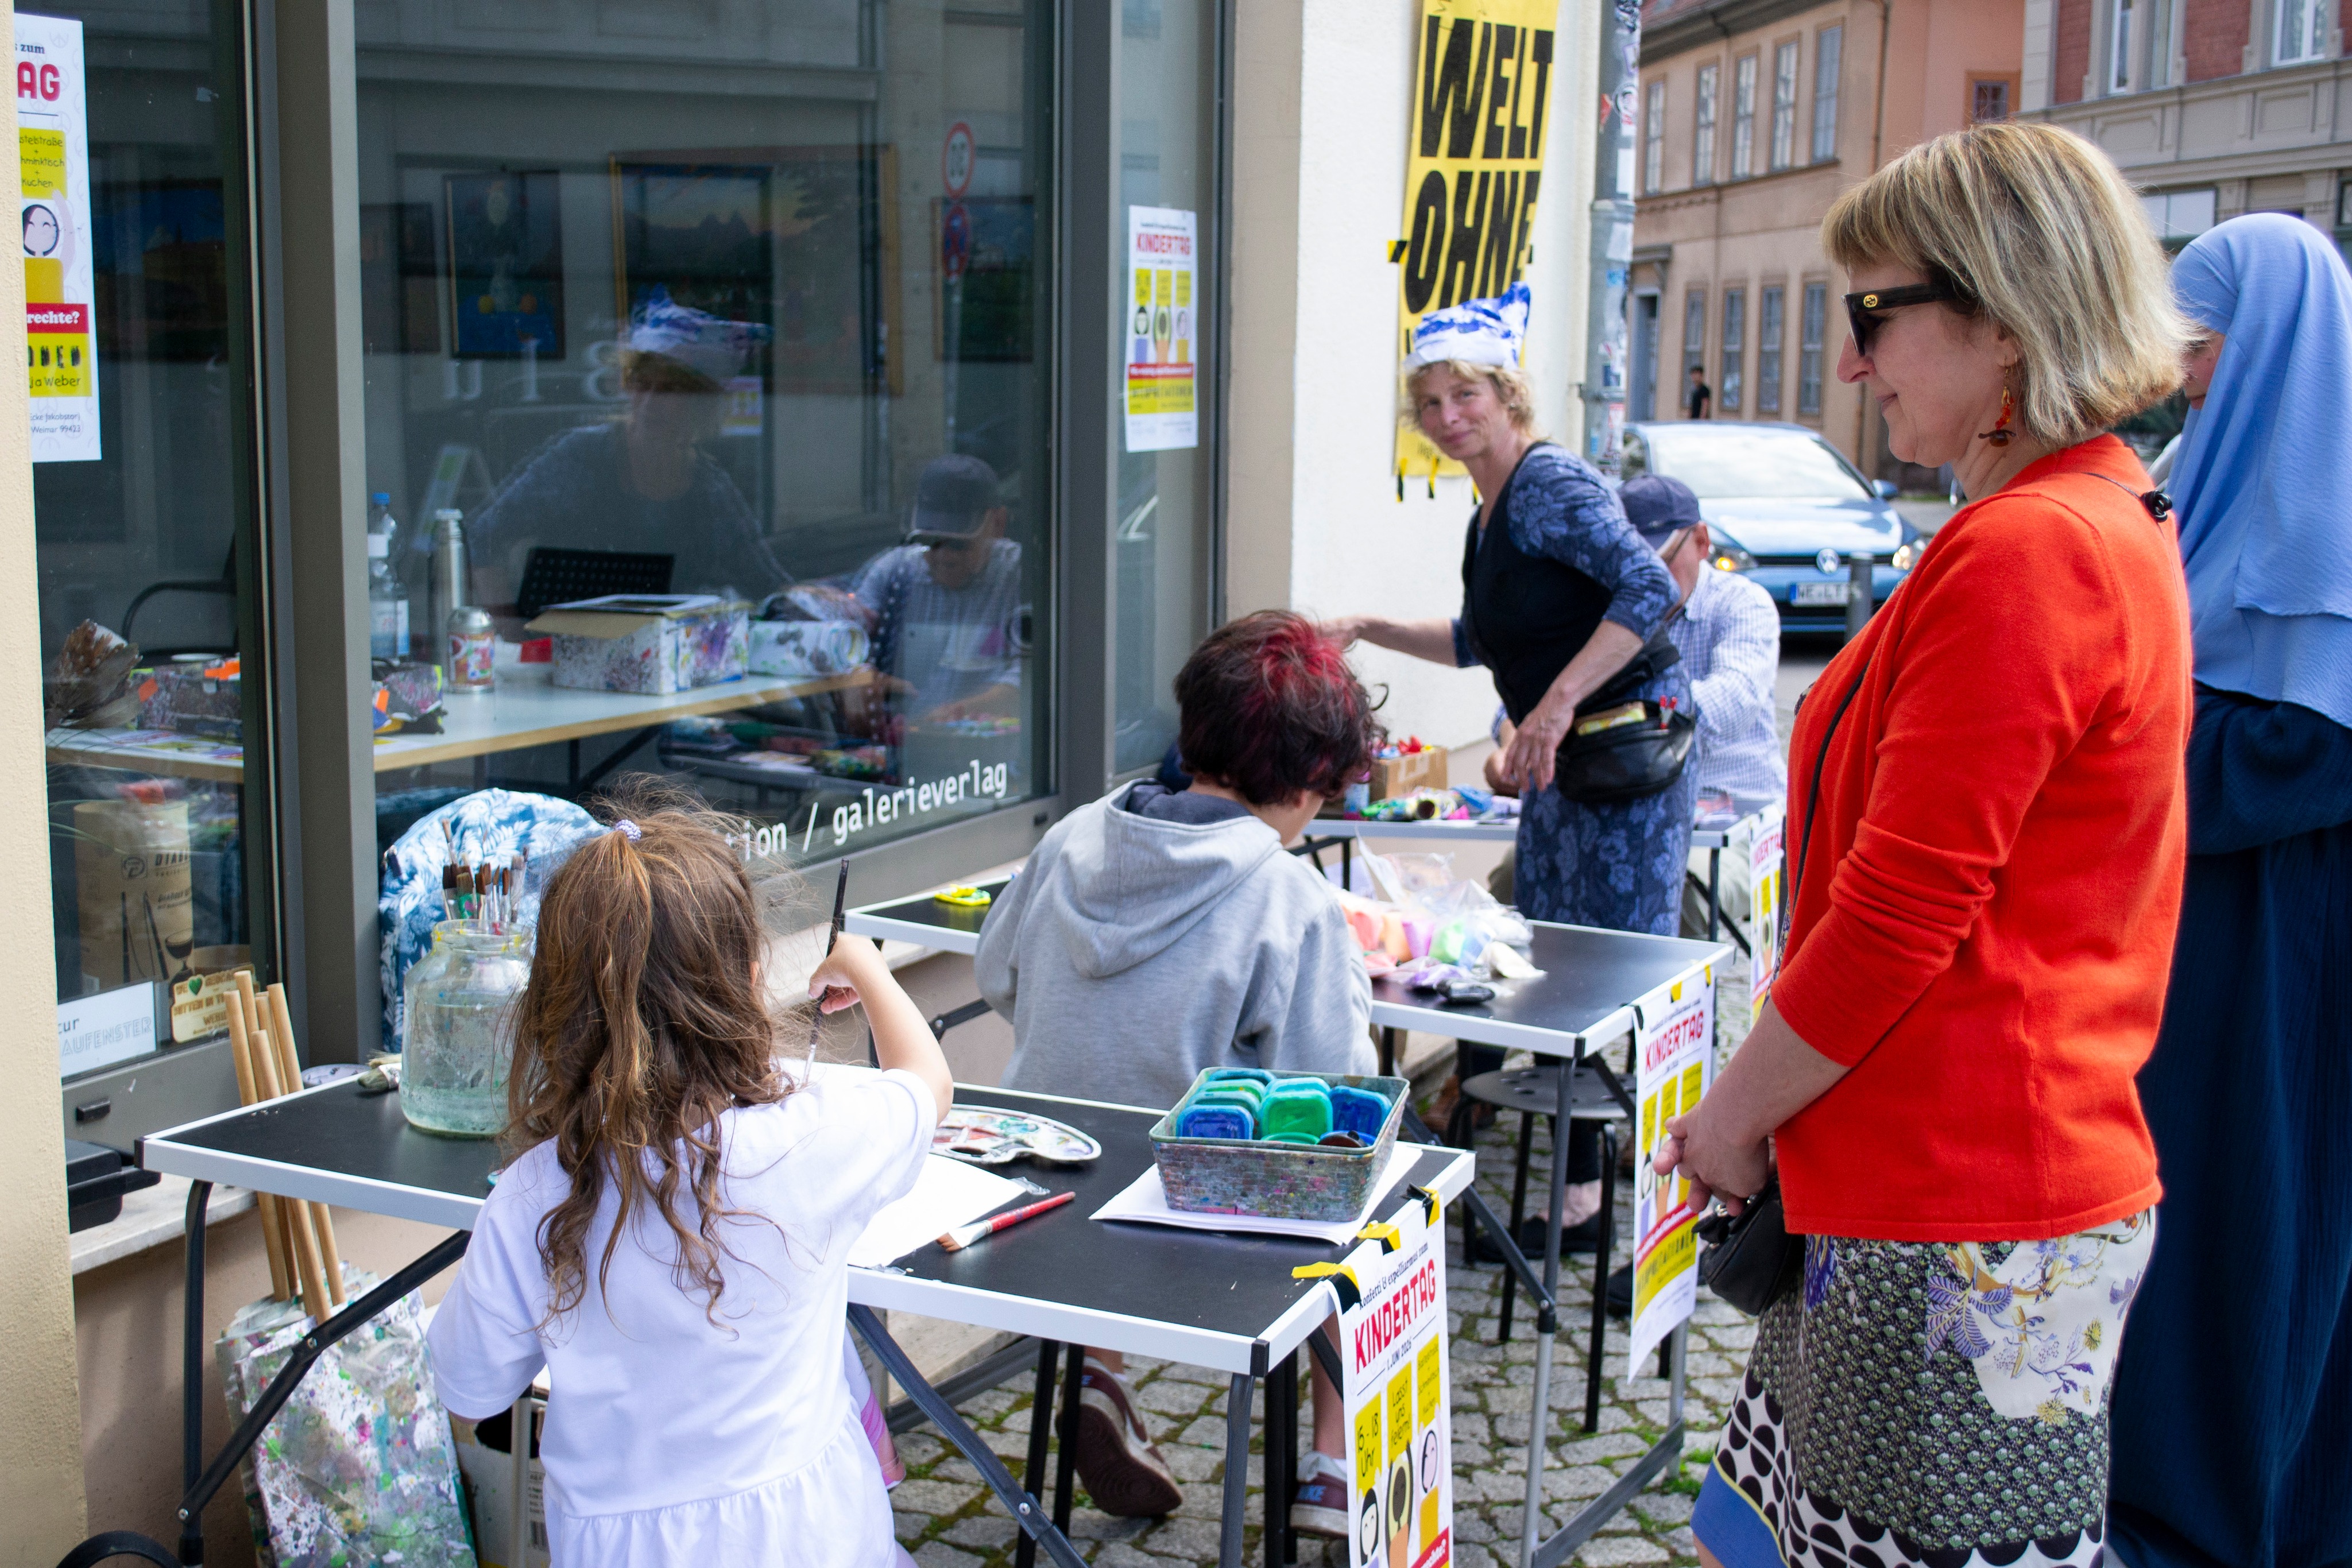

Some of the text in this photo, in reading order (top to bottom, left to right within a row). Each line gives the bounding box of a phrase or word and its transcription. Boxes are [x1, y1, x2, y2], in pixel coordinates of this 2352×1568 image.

[21, 43, 45, 54] zum
[1419, 15, 1554, 159] WELT
[1136, 233, 1190, 255] KINDERTAG
[1405, 170, 1541, 313] OHNE
[44, 374, 81, 386] Weber
[60, 425, 81, 433] 99423
[833, 759, 1007, 846] galerieverlag
[61, 1016, 152, 1056] AUFENSTER
[1645, 1010, 1704, 1075] KINDERTAG
[1355, 1258, 1436, 1375] KINDERTAG
[1361, 1446, 1375, 1477] Uhr
